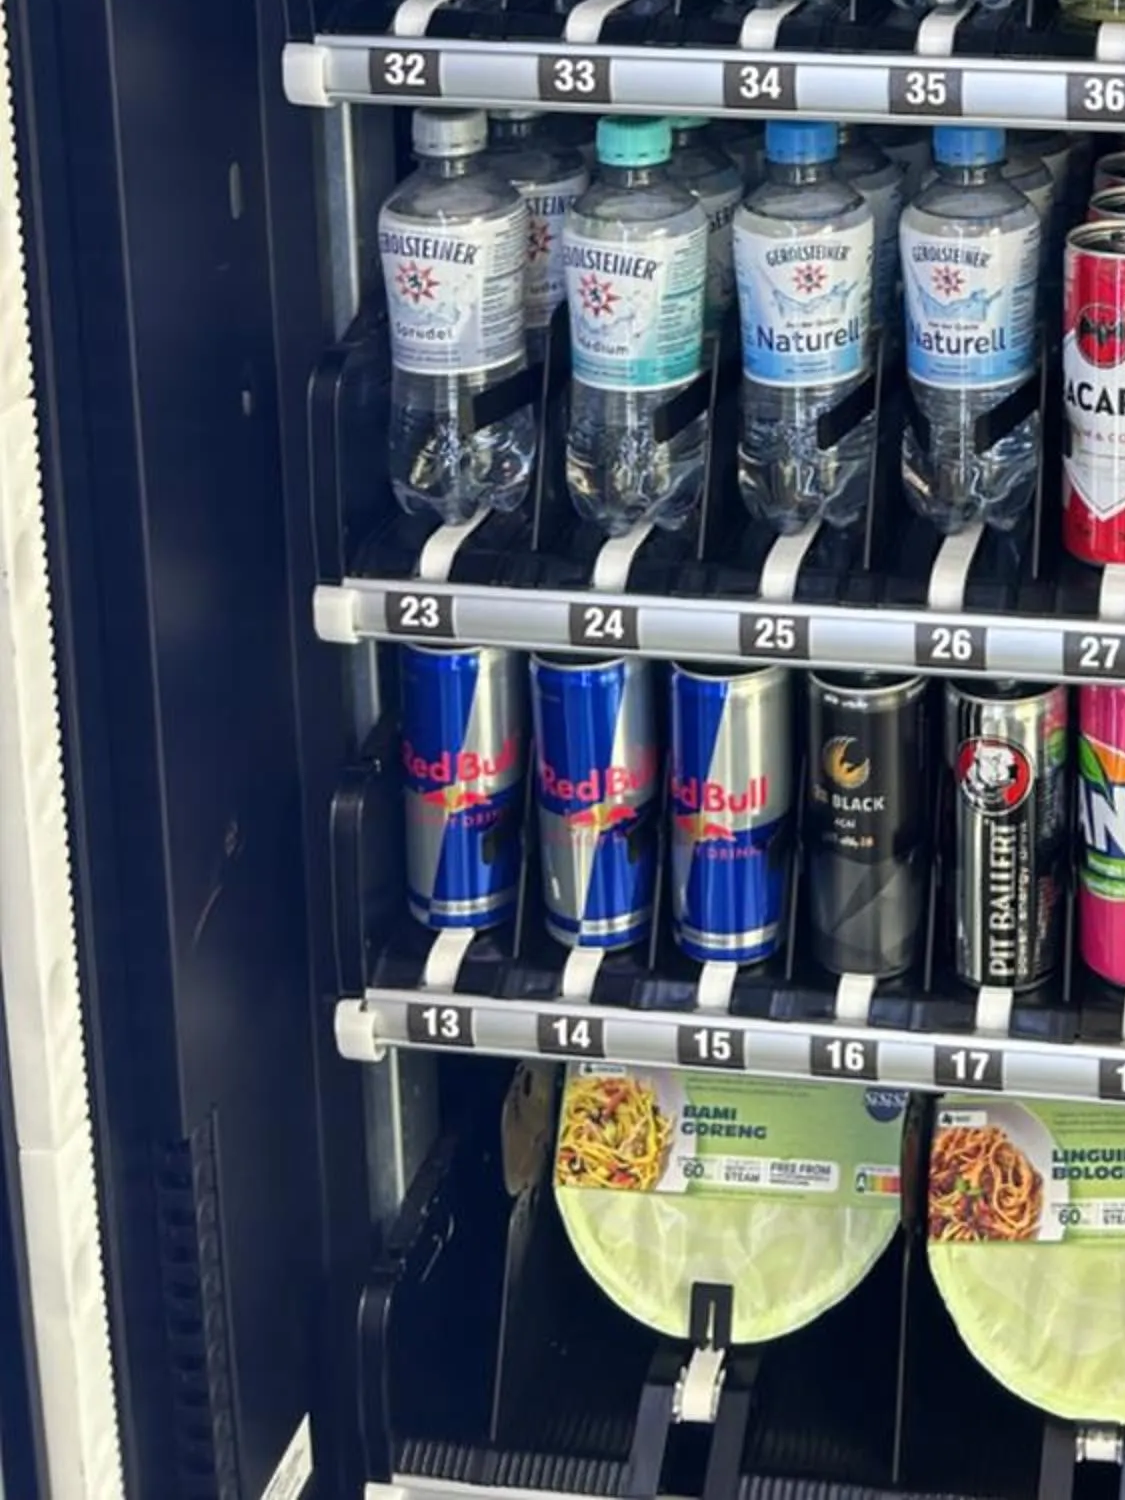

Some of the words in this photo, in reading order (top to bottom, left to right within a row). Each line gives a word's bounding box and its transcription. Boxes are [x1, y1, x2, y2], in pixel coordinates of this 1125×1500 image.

[384, 52, 426, 86] 32
[554, 58, 596, 93] 33
[739, 65, 782, 99] 34
[905, 70, 947, 105] 35
[765, 243, 849, 268] GEROLSTEINER
[756, 319, 861, 354] Naturell
[400, 595, 440, 628] 23
[584, 606, 625, 639] 24
[754, 617, 795, 650] 25
[930, 627, 972, 661] 26
[1079, 635, 1121, 669] 27
[541, 761, 599, 801] Red
[703, 773, 769, 813] Bull
[832, 793, 885, 812] BLACK
[988, 933, 1016, 977] PIT
[422, 1007, 460, 1038] 13
[552, 1017, 591, 1048] 14
[693, 1028, 731, 1060] 15
[825, 1039, 865, 1071] 16
[950, 1049, 990, 1081] 17
[681, 1104, 737, 1121] BAMI
[680, 1120, 768, 1140] GORENG
[682, 1161, 705, 1179] 60
[725, 1171, 761, 1182] STEAM
[799, 1163, 832, 1176] FROM
[1058, 1207, 1081, 1225] 60
